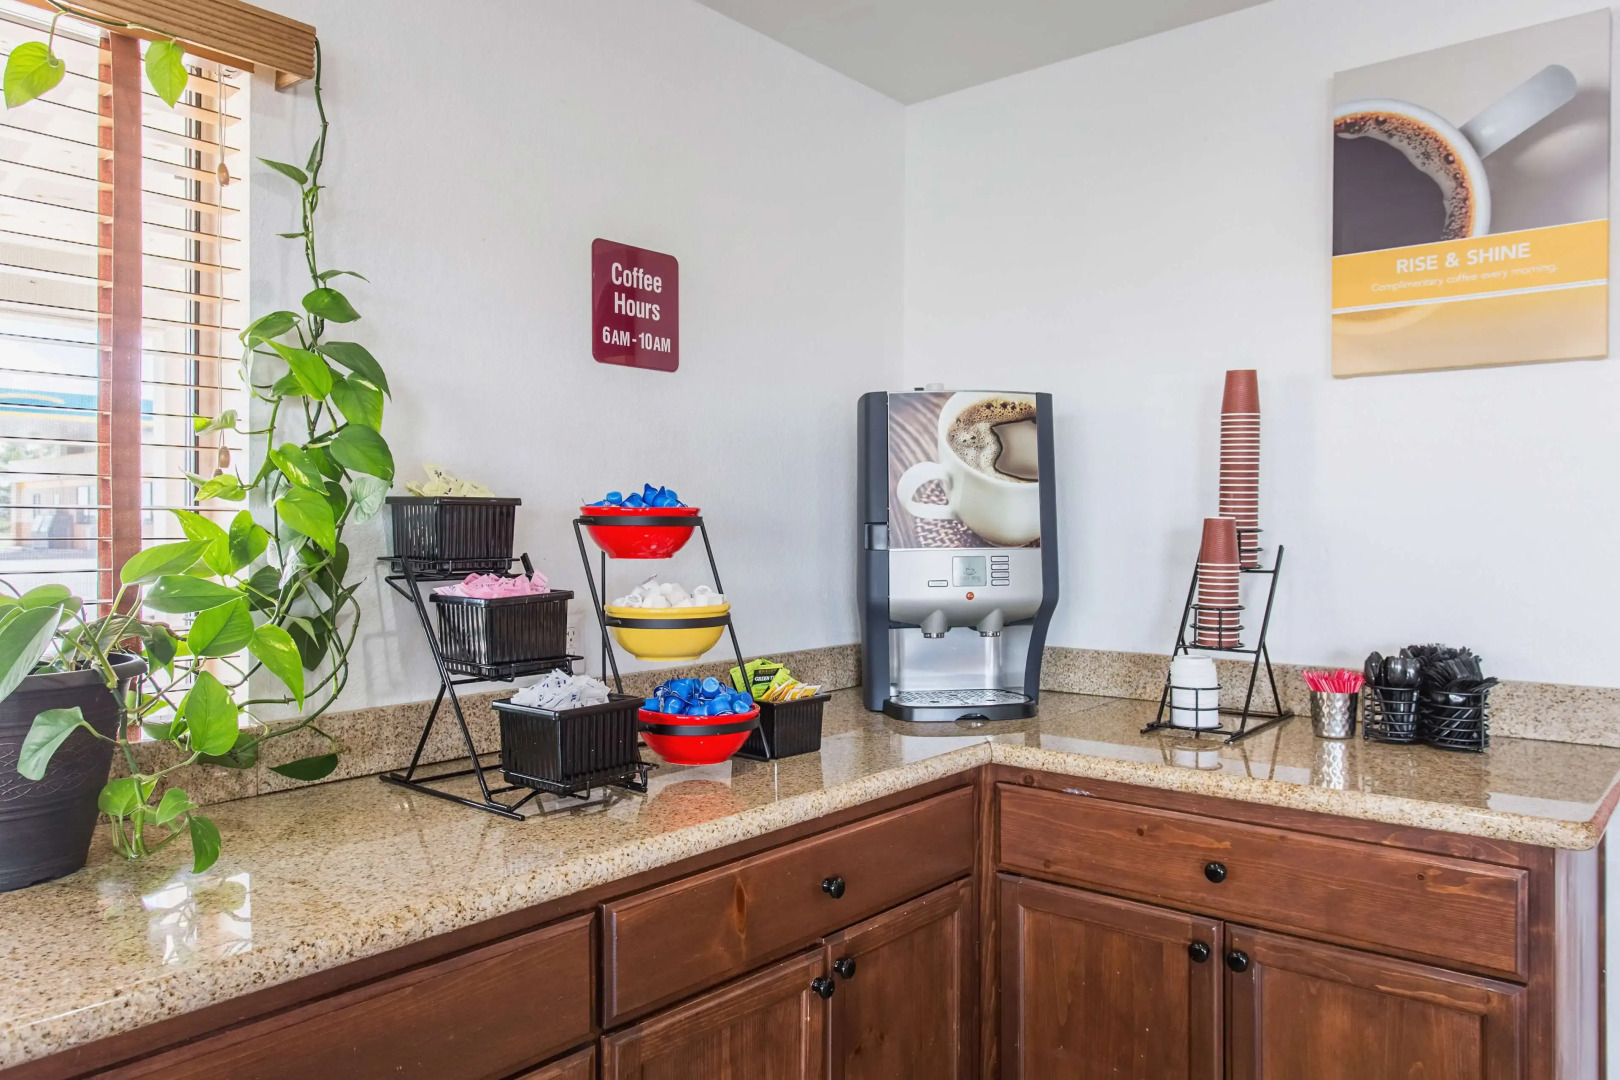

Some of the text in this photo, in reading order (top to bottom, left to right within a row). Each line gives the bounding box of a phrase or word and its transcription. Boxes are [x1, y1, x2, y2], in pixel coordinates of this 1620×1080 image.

[1396, 242, 1531, 274] RISE & SHINE
[611, 262, 662, 293] Coffee
[1370, 278, 1443, 292] Complimentary
[1446, 272, 1478, 284] coffee
[1481, 270, 1508, 280] every
[614, 291, 661, 321] Hours
